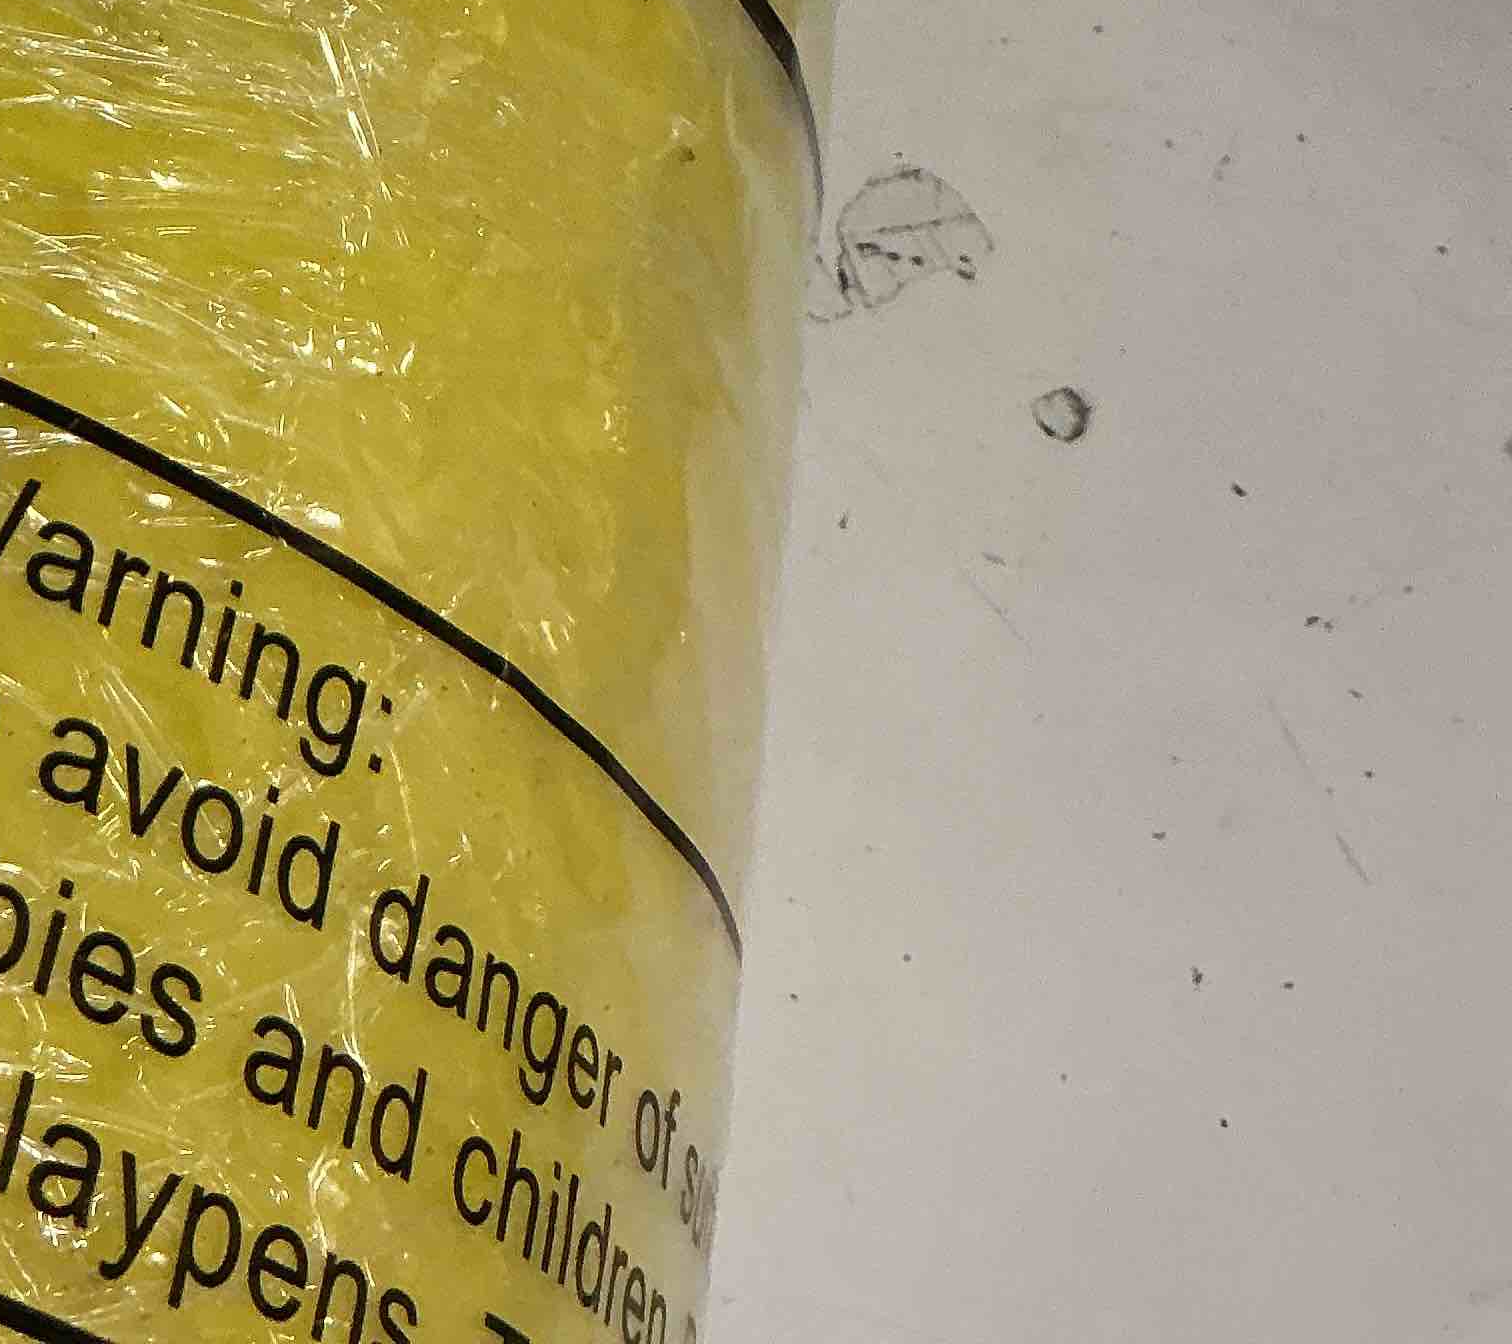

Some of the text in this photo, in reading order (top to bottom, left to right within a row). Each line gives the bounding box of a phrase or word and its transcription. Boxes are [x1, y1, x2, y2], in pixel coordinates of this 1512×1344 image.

[38, 718, 340, 931] avoid
[370, 875, 622, 1128] danger
[636, 1089, 680, 1190] of
[243, 1016, 428, 1184] and
[453, 1128, 666, 1344] children
